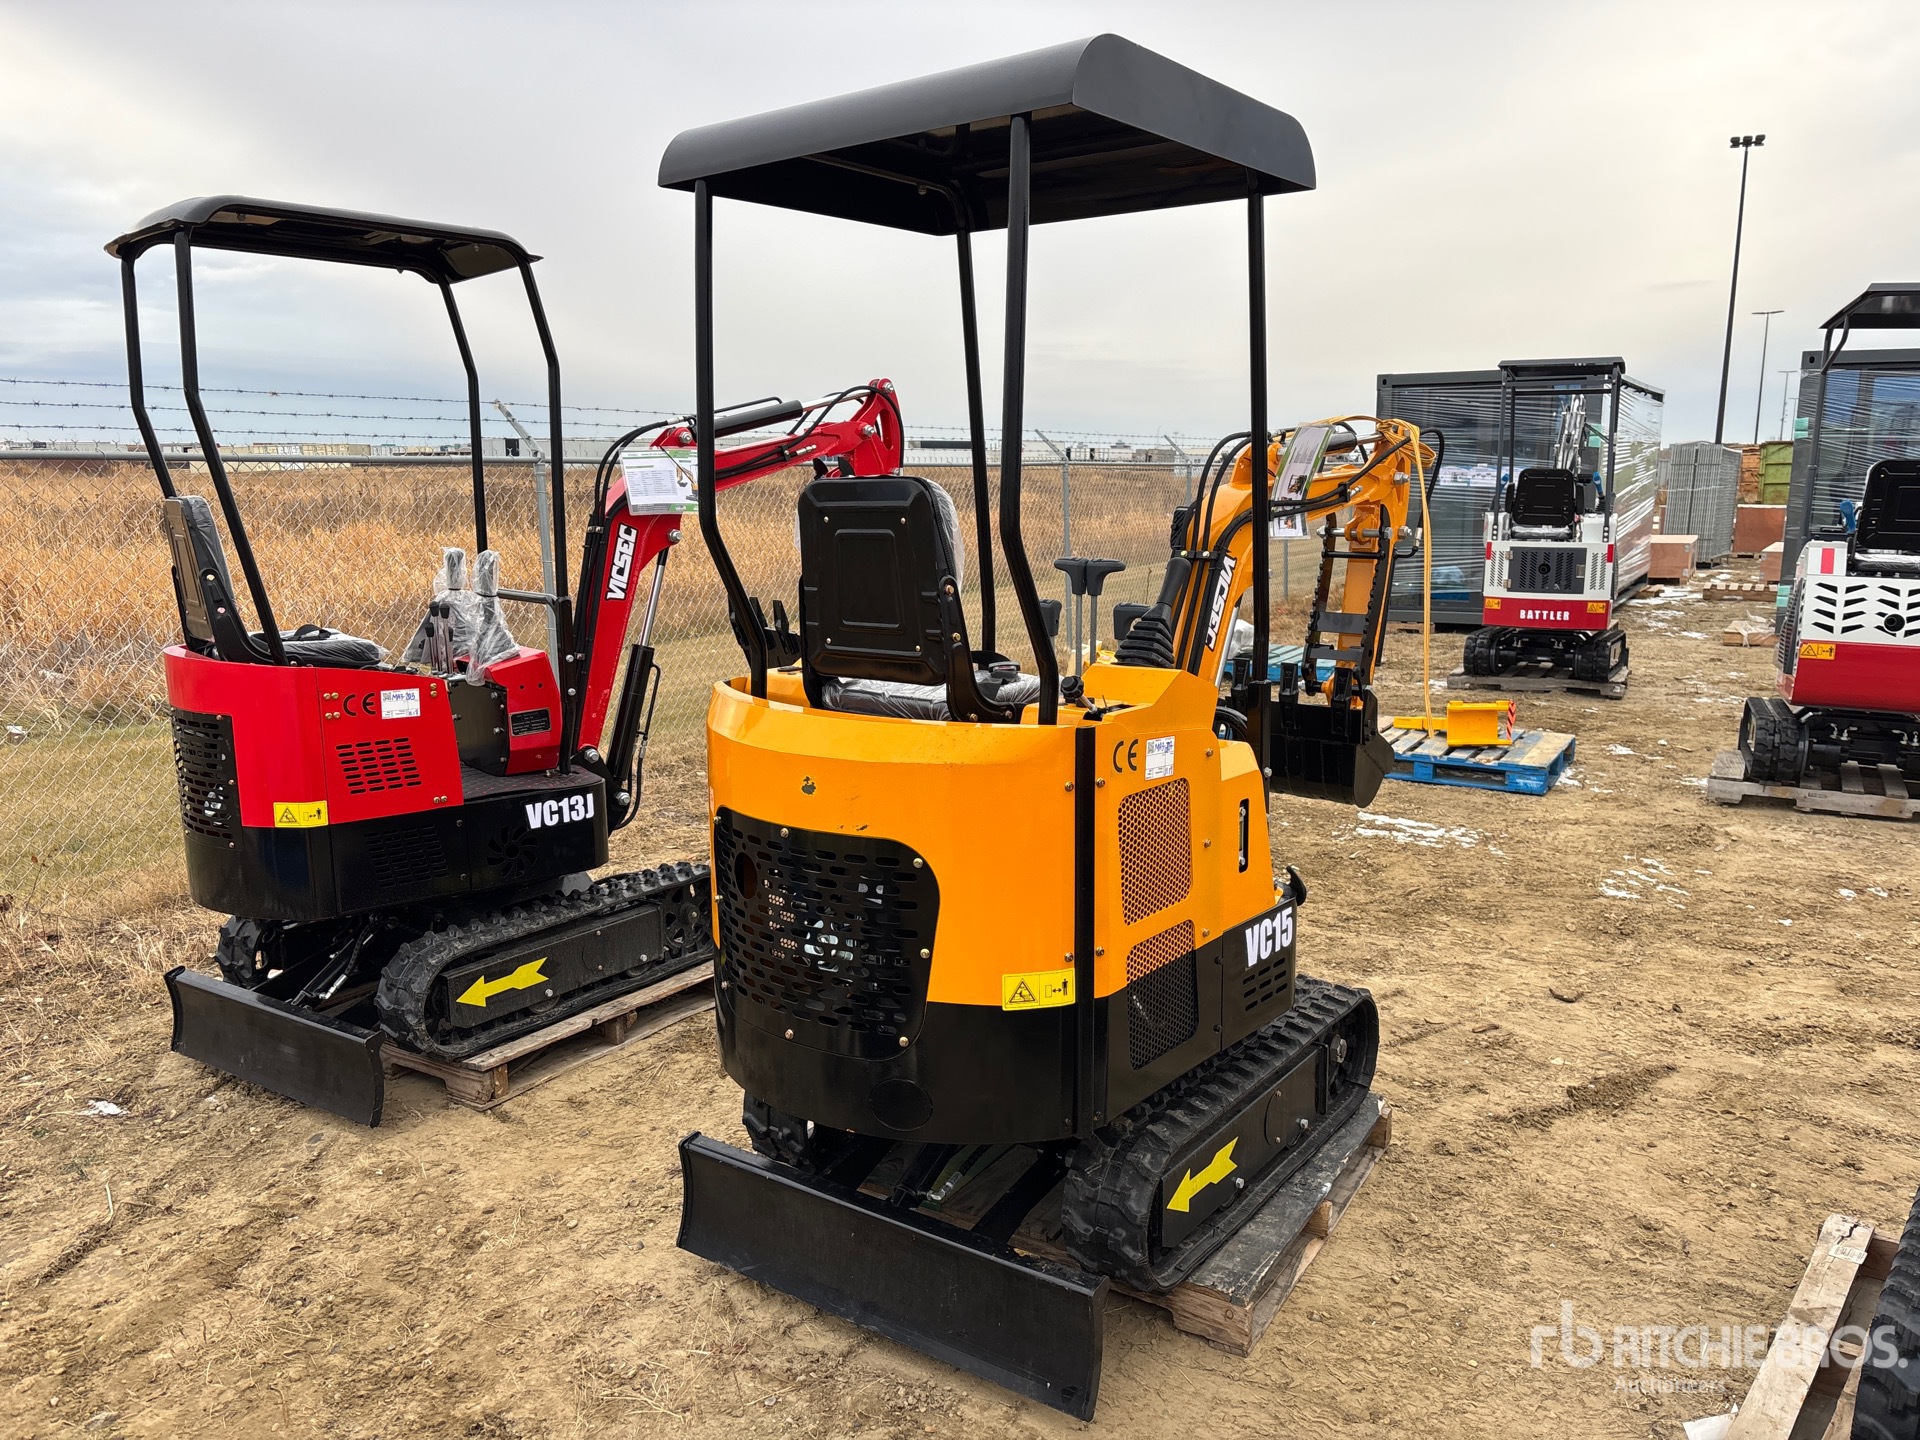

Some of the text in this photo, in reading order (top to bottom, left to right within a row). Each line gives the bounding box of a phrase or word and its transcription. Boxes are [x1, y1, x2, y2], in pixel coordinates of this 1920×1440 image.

[606, 524, 638, 601] VICSEC
[1205, 556, 1236, 650] VICSEC
[1519, 609, 1570, 621] BATTLER
[343, 692, 376, 717] CE
[1113, 739, 1138, 773] CE
[525, 793, 595, 829] VC13J
[1245, 906, 1293, 967] VC15
